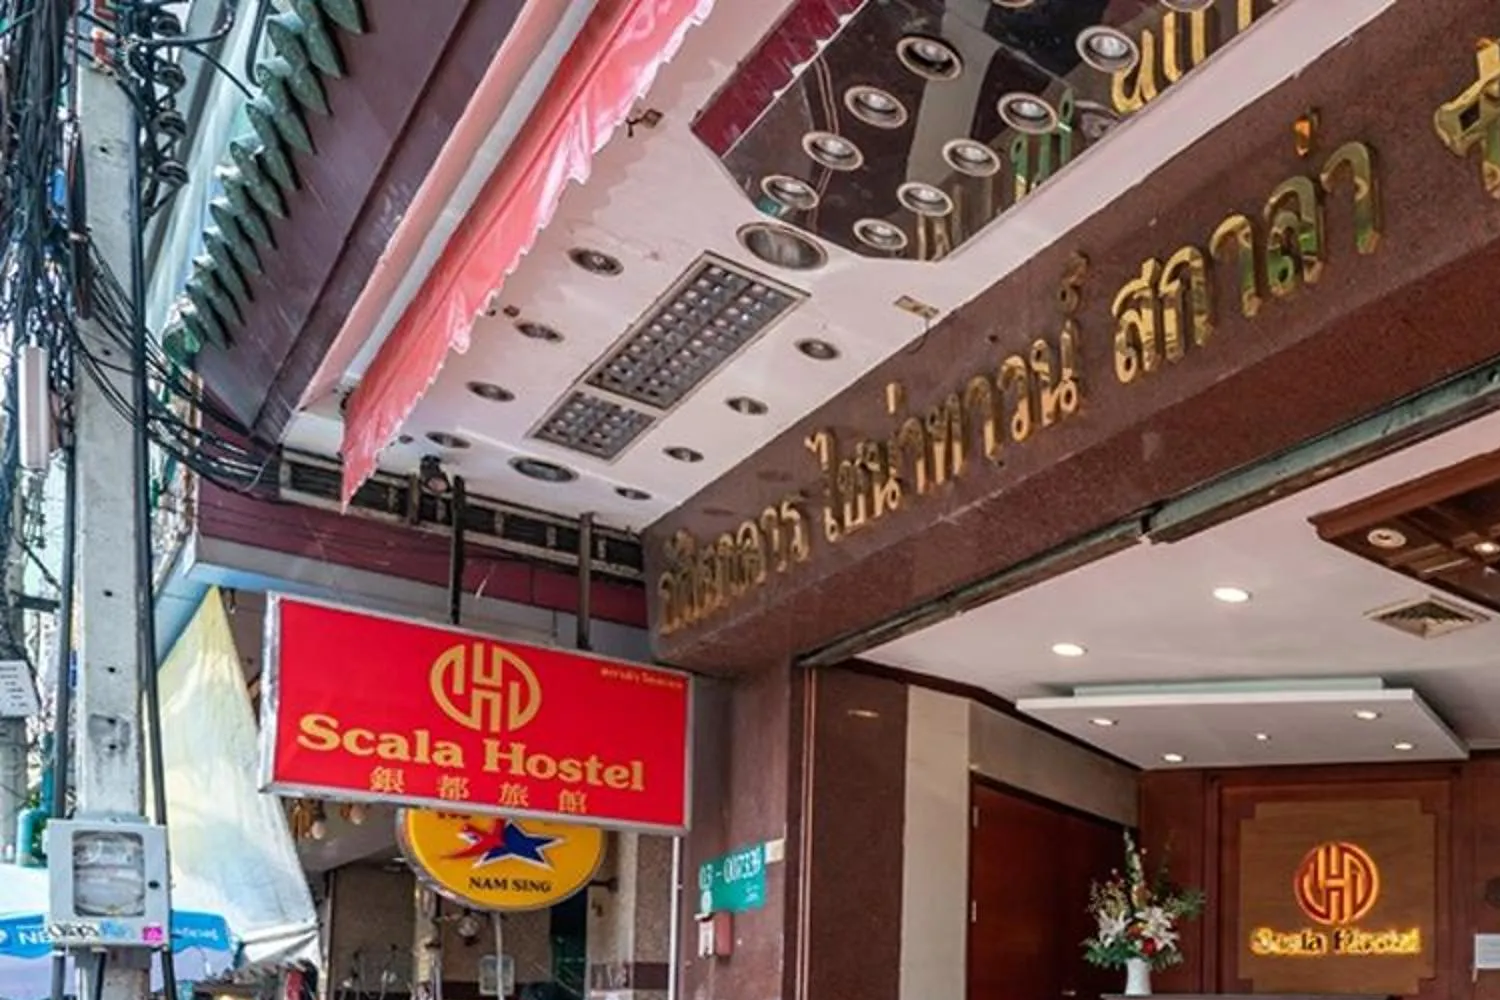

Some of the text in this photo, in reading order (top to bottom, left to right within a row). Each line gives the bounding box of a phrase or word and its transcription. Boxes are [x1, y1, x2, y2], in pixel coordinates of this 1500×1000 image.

[1111, 110, 1382, 384] สกาล่า
[297, 713, 645, 793] Scala Hostel
[469, 876, 552, 894] NAM SING
